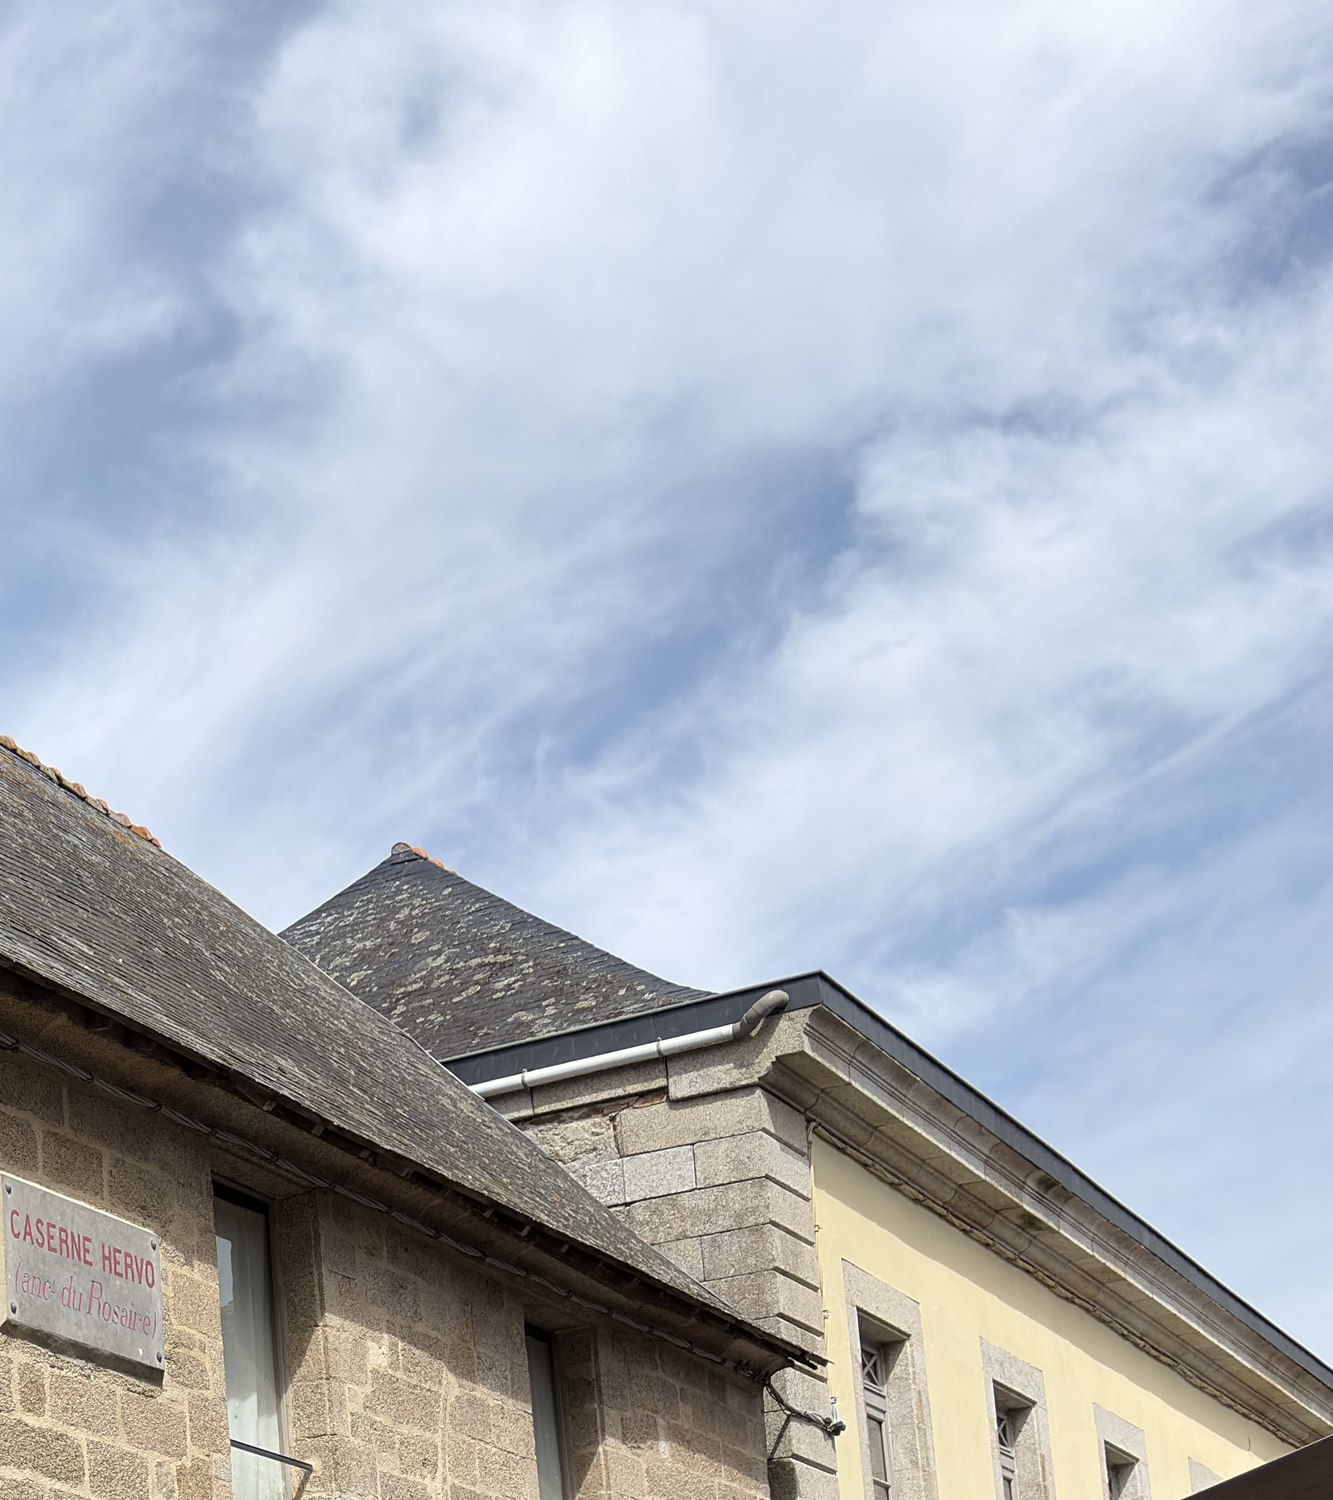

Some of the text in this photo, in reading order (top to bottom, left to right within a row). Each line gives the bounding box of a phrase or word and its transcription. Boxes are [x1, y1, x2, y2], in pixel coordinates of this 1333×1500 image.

[10, 1209, 156, 1289] CASERNE HERVO
[61, 1276, 83, 1312] du
[86, 1279, 158, 1341] Rosaire)
